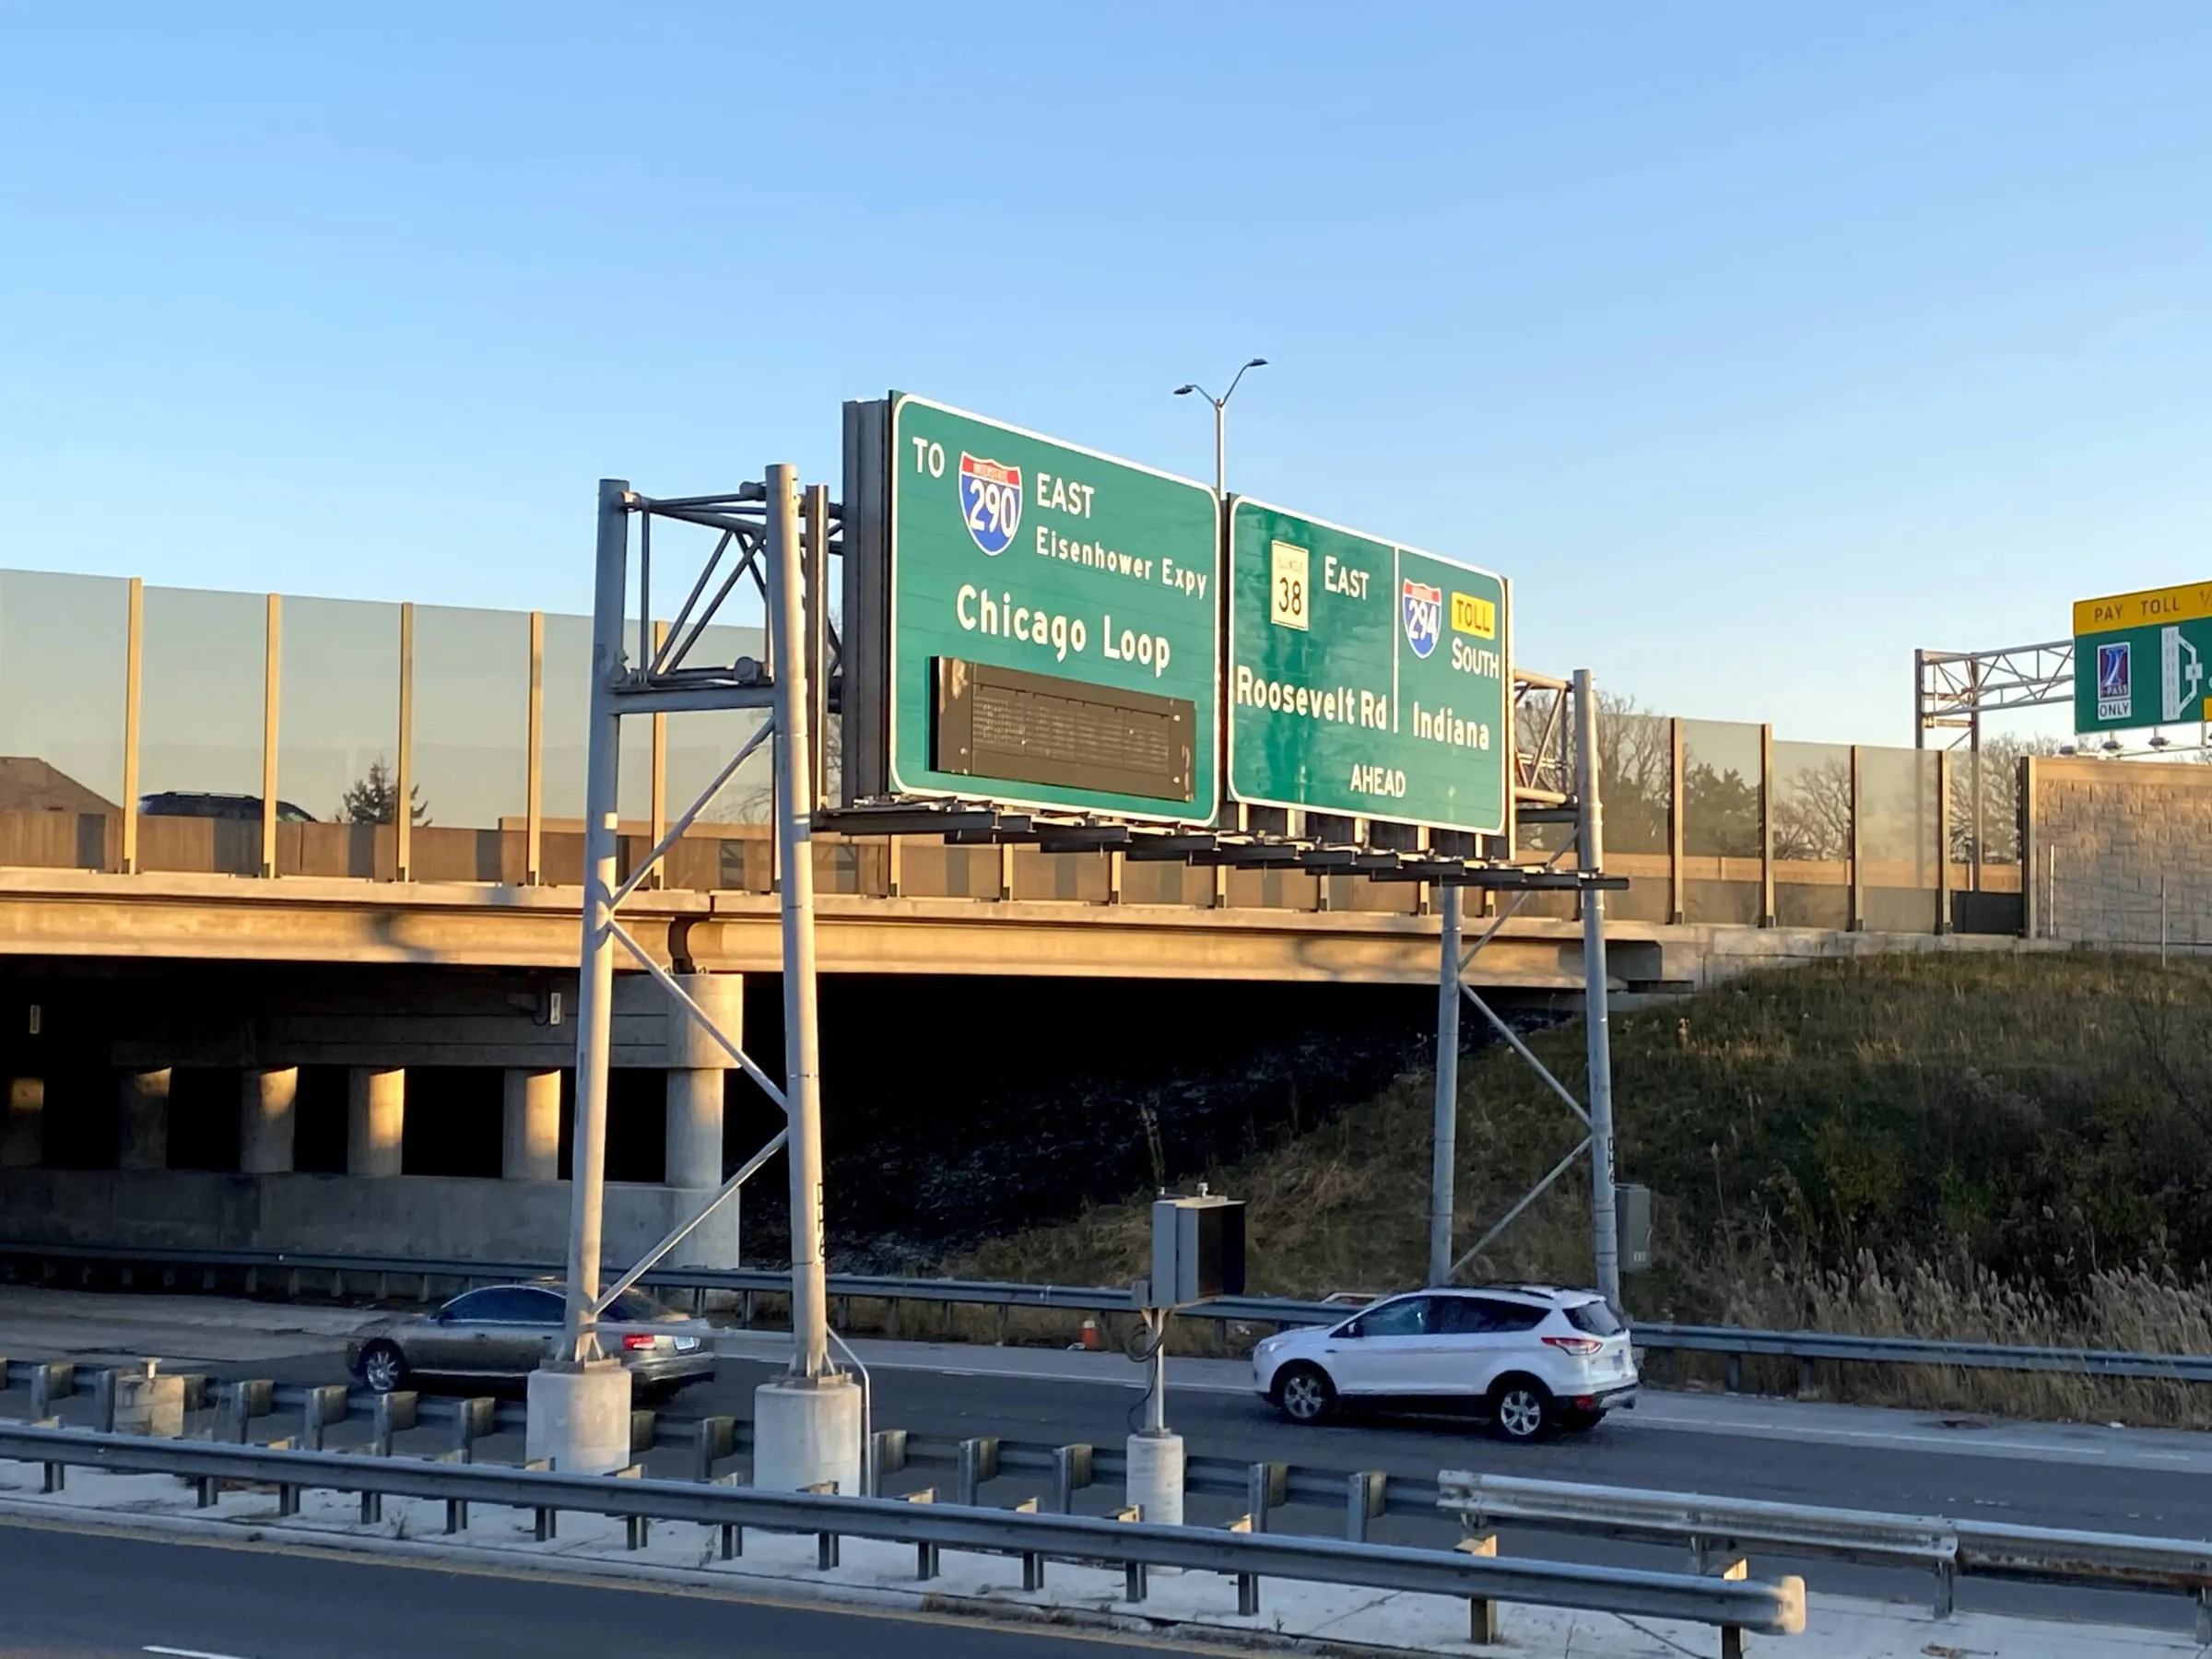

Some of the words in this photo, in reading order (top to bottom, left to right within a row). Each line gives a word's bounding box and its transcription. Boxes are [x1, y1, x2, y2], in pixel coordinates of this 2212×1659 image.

[912, 436, 946, 478] TO
[969, 477, 1017, 538] 290
[1036, 472, 1095, 519] EAST
[1036, 526, 1152, 581] Eisenhower
[1161, 558, 1207, 600] Expy
[1324, 555, 1370, 601] EAST
[1278, 576, 1302, 616] 38
[1455, 599, 1491, 633] TOLL
[2094, 603, 2124, 623] PAY
[2140, 595, 2181, 617] TOLL
[956, 583, 1088, 661] Chicago
[1103, 615, 1171, 678] Loop
[1407, 599, 1438, 646] 294
[1451, 636, 1500, 680] SOUTH
[1237, 665, 1355, 725] Roosevelt
[1359, 689, 1387, 731] Rd
[2100, 701, 2129, 717] ONLY
[1412, 700, 1489, 751] Indiana
[1349, 763, 1406, 798] AHEAD
